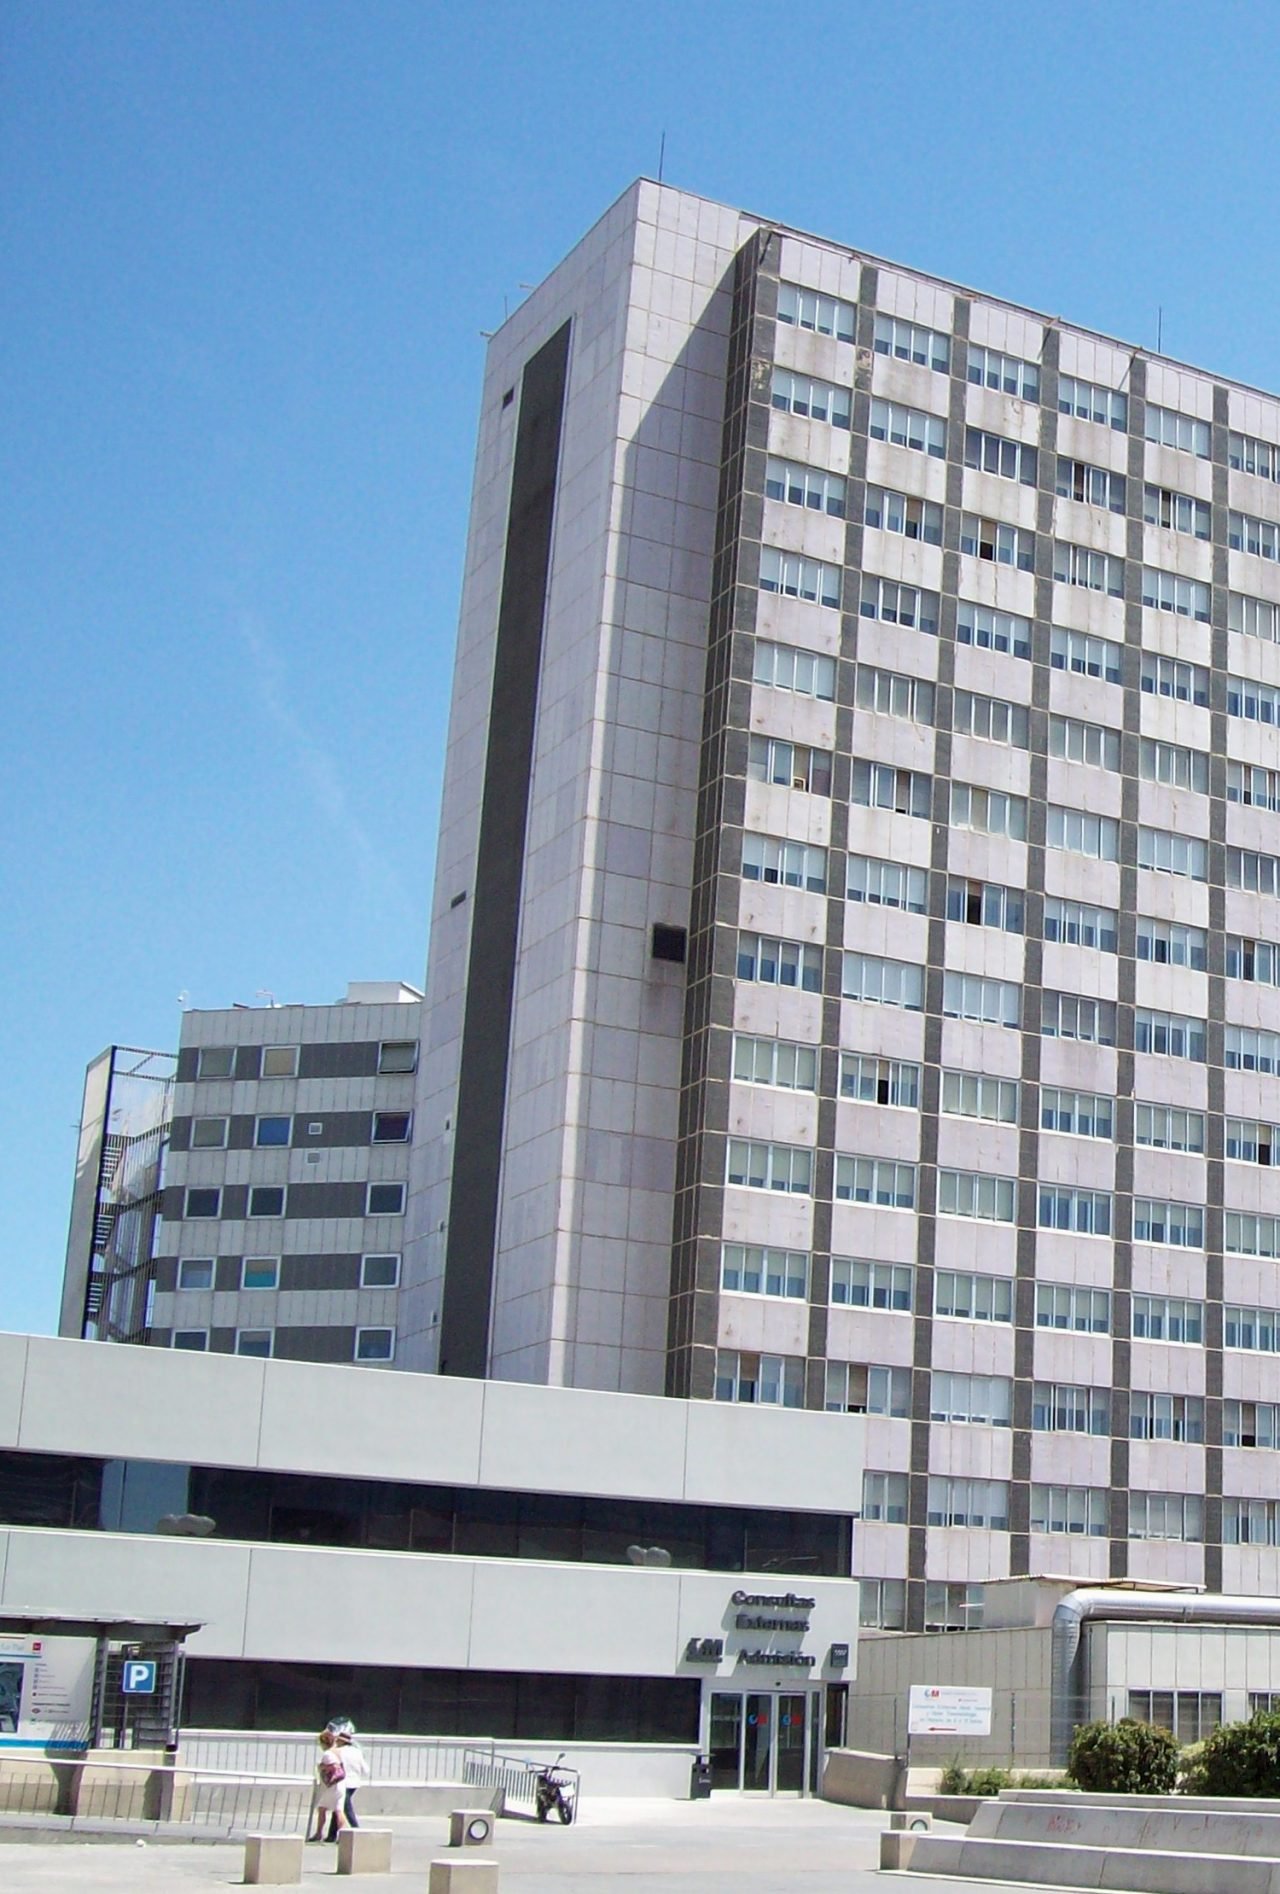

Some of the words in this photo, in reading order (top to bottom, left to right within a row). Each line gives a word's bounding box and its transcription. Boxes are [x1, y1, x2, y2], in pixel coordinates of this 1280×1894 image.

[732, 1590, 815, 1608] Consultas
[736, 1614, 810, 1632] Externas
[737, 1648, 816, 1666] Admisión
[130, 1665, 149, 1689] P
